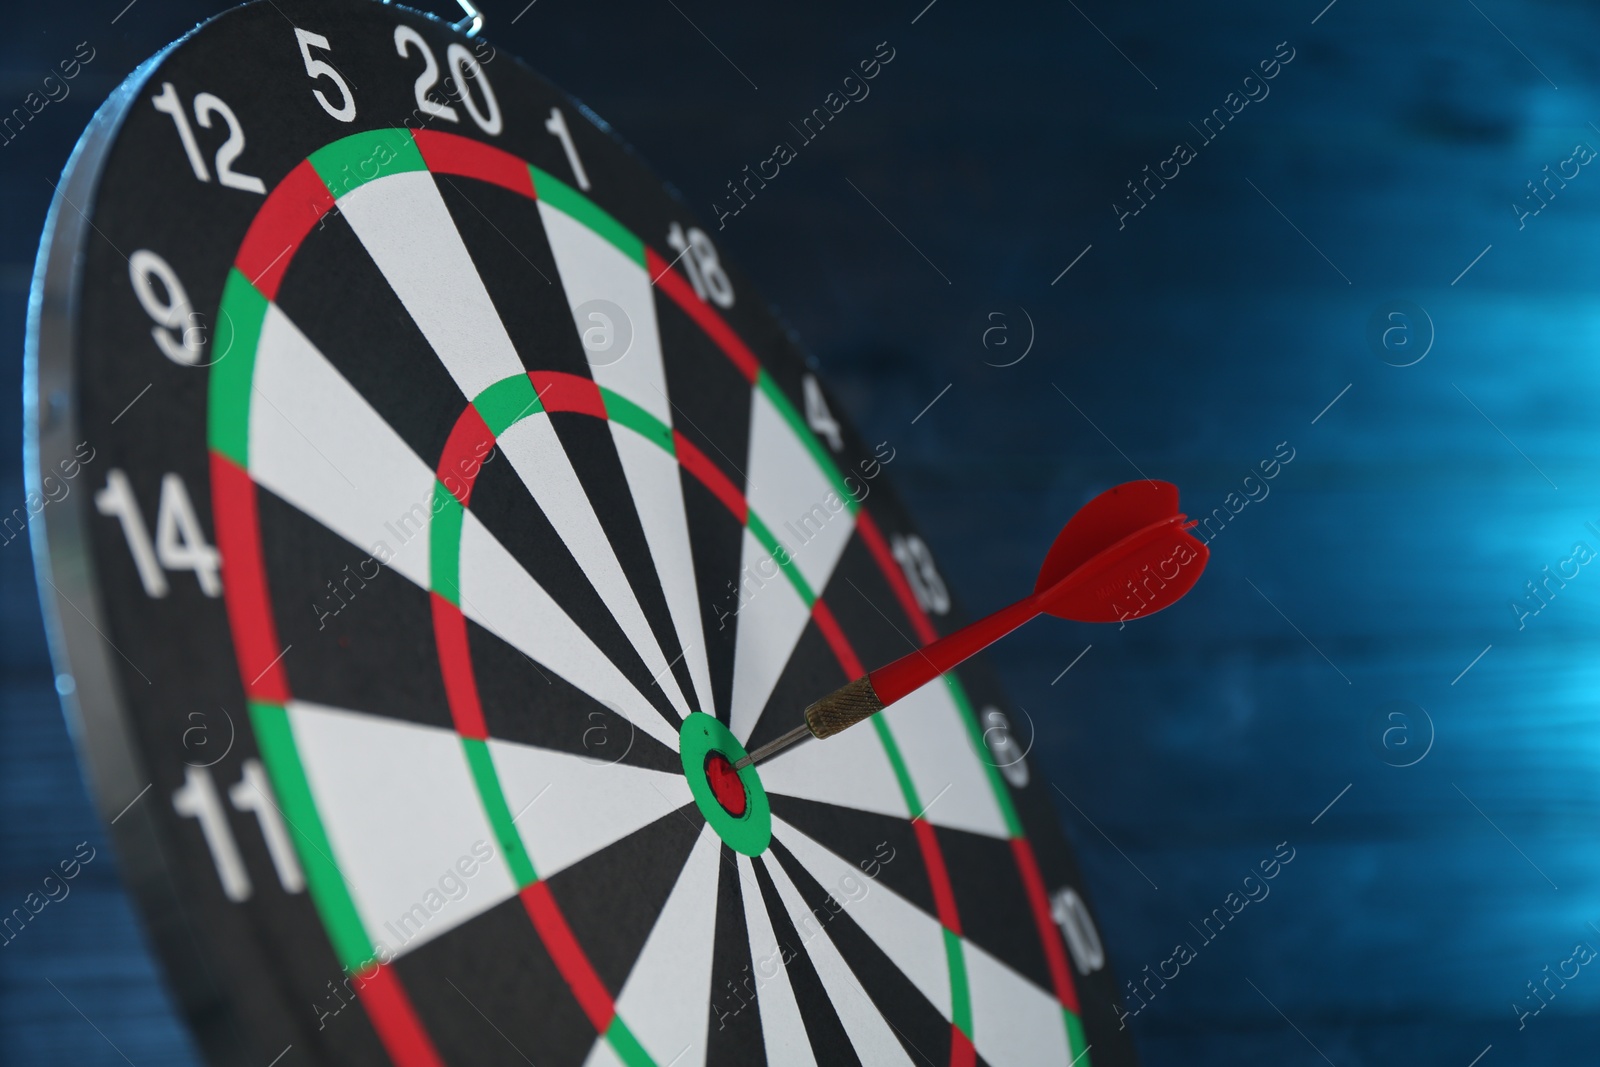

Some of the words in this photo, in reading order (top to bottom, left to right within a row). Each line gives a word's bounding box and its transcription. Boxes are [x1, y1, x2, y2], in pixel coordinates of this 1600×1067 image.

[294, 27, 357, 122] 5
[394, 25, 502, 136] 20
[152, 82, 267, 195] 12
[546, 108, 590, 190] 1
[128, 249, 203, 367] 9
[666, 222, 735, 308] 18
[803, 375, 843, 451] 4
[95, 469, 221, 599] 14
[892, 534, 950, 615] 13
[982, 706, 1030, 787] 6
[173, 762, 304, 901] 11
[1050, 886, 1105, 975] 10
